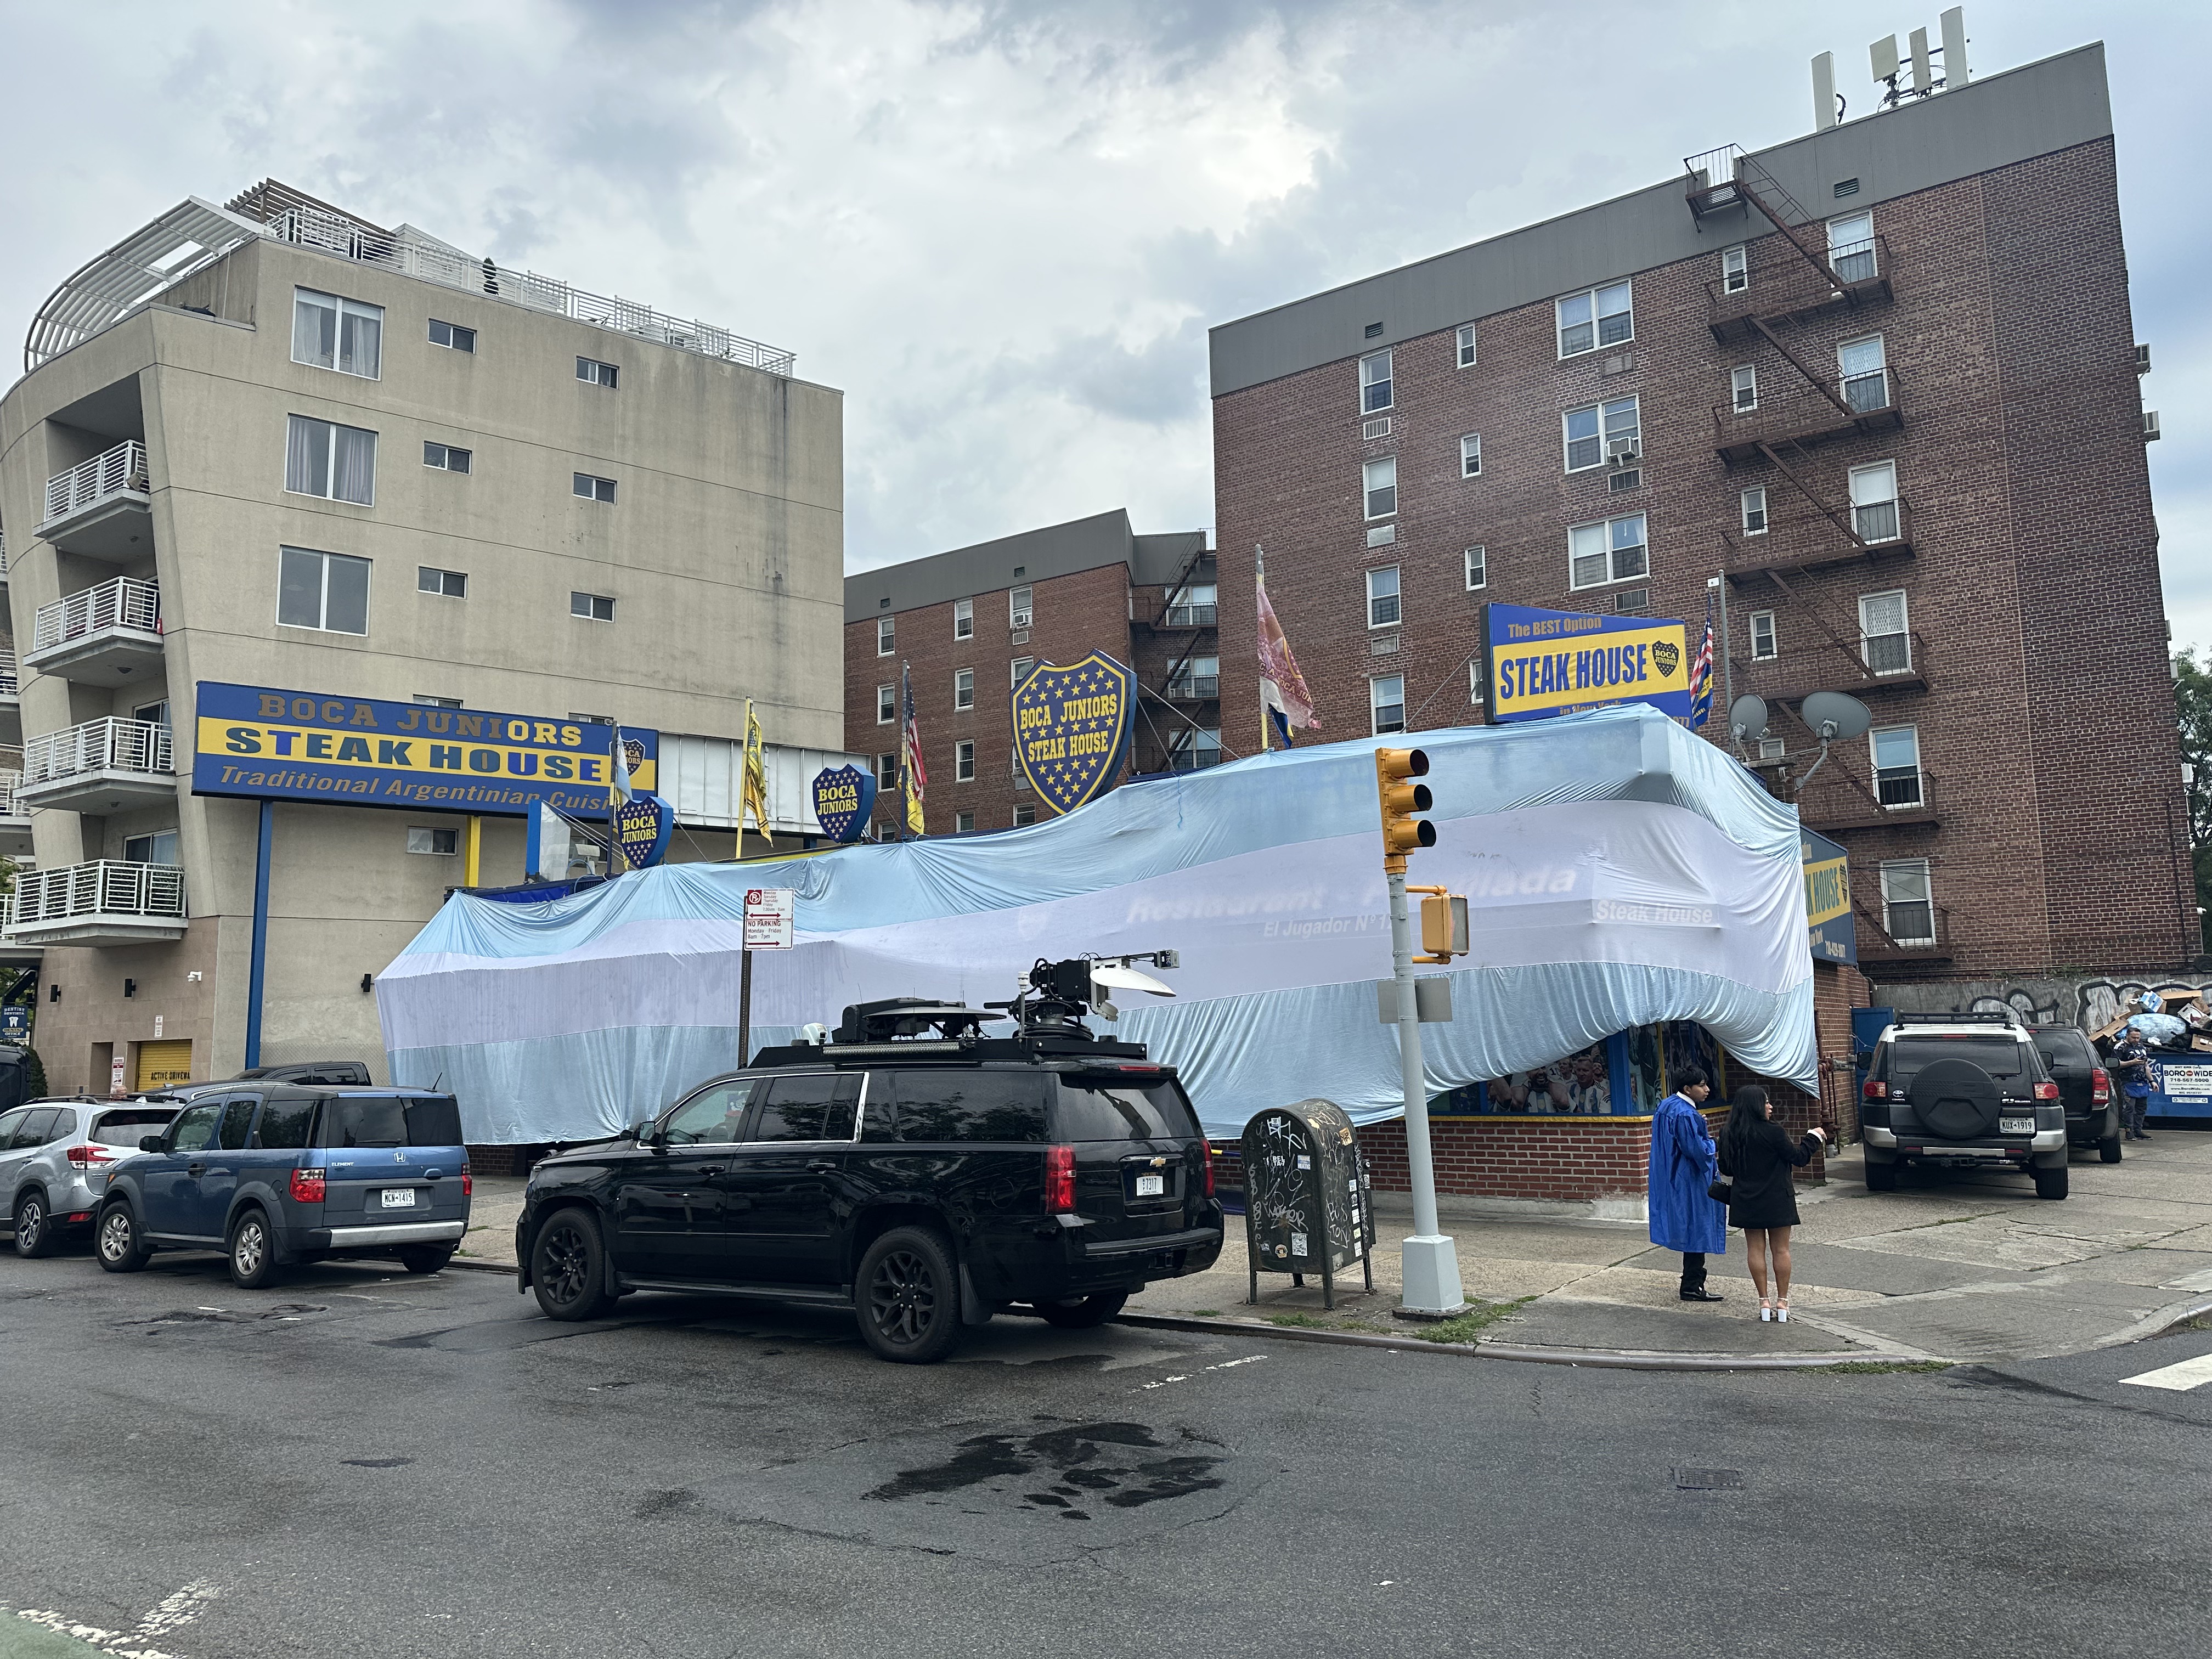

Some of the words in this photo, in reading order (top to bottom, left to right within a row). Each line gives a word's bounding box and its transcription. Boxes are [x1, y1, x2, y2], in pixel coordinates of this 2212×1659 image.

[1508, 623, 1530, 638] The
[1533, 619, 1561, 635] BEST
[1564, 617, 1601, 633] Option
[1655, 649, 1676, 659] BOCA
[1655, 656, 1677, 665] JUNIORS
[1500, 653, 1570, 699] STEAK
[1576, 644, 1647, 689] HOUSE
[258, 694, 378, 727] BOCA
[397, 709, 582, 746] JUNIORS
[1020, 705, 1052, 730] BOCA
[1060, 693, 1117, 723] JUNIORS
[1559, 707, 1570, 715] in
[225, 727, 413, 766] STEAK
[430, 744, 602, 782] HOUSE
[624, 749, 641, 758] OCA
[1028, 737, 1065, 763] STEAK
[1069, 731, 1109, 757] HOUSE
[221, 765, 380, 794] Traditional
[549, 791, 610, 811] Cuisi
[818, 785, 857, 802] BOCA
[817, 798, 858, 816] JUNIORS
[622, 815, 656, 831] BOCA
[621, 828, 657, 844] JUNIORS
[1813, 867, 1839, 913] HOUSE
[1596, 900, 1648, 921] Steak
[1655, 907, 1713, 923] House
[1263, 921, 1279, 936] El
[1283, 917, 1351, 939] Jugador
[151, 1071, 168, 1080] ACTIVE
[169, 1071, 190, 1080] DRIVEWA
[1146, 1177, 1157, 1190] 7317
